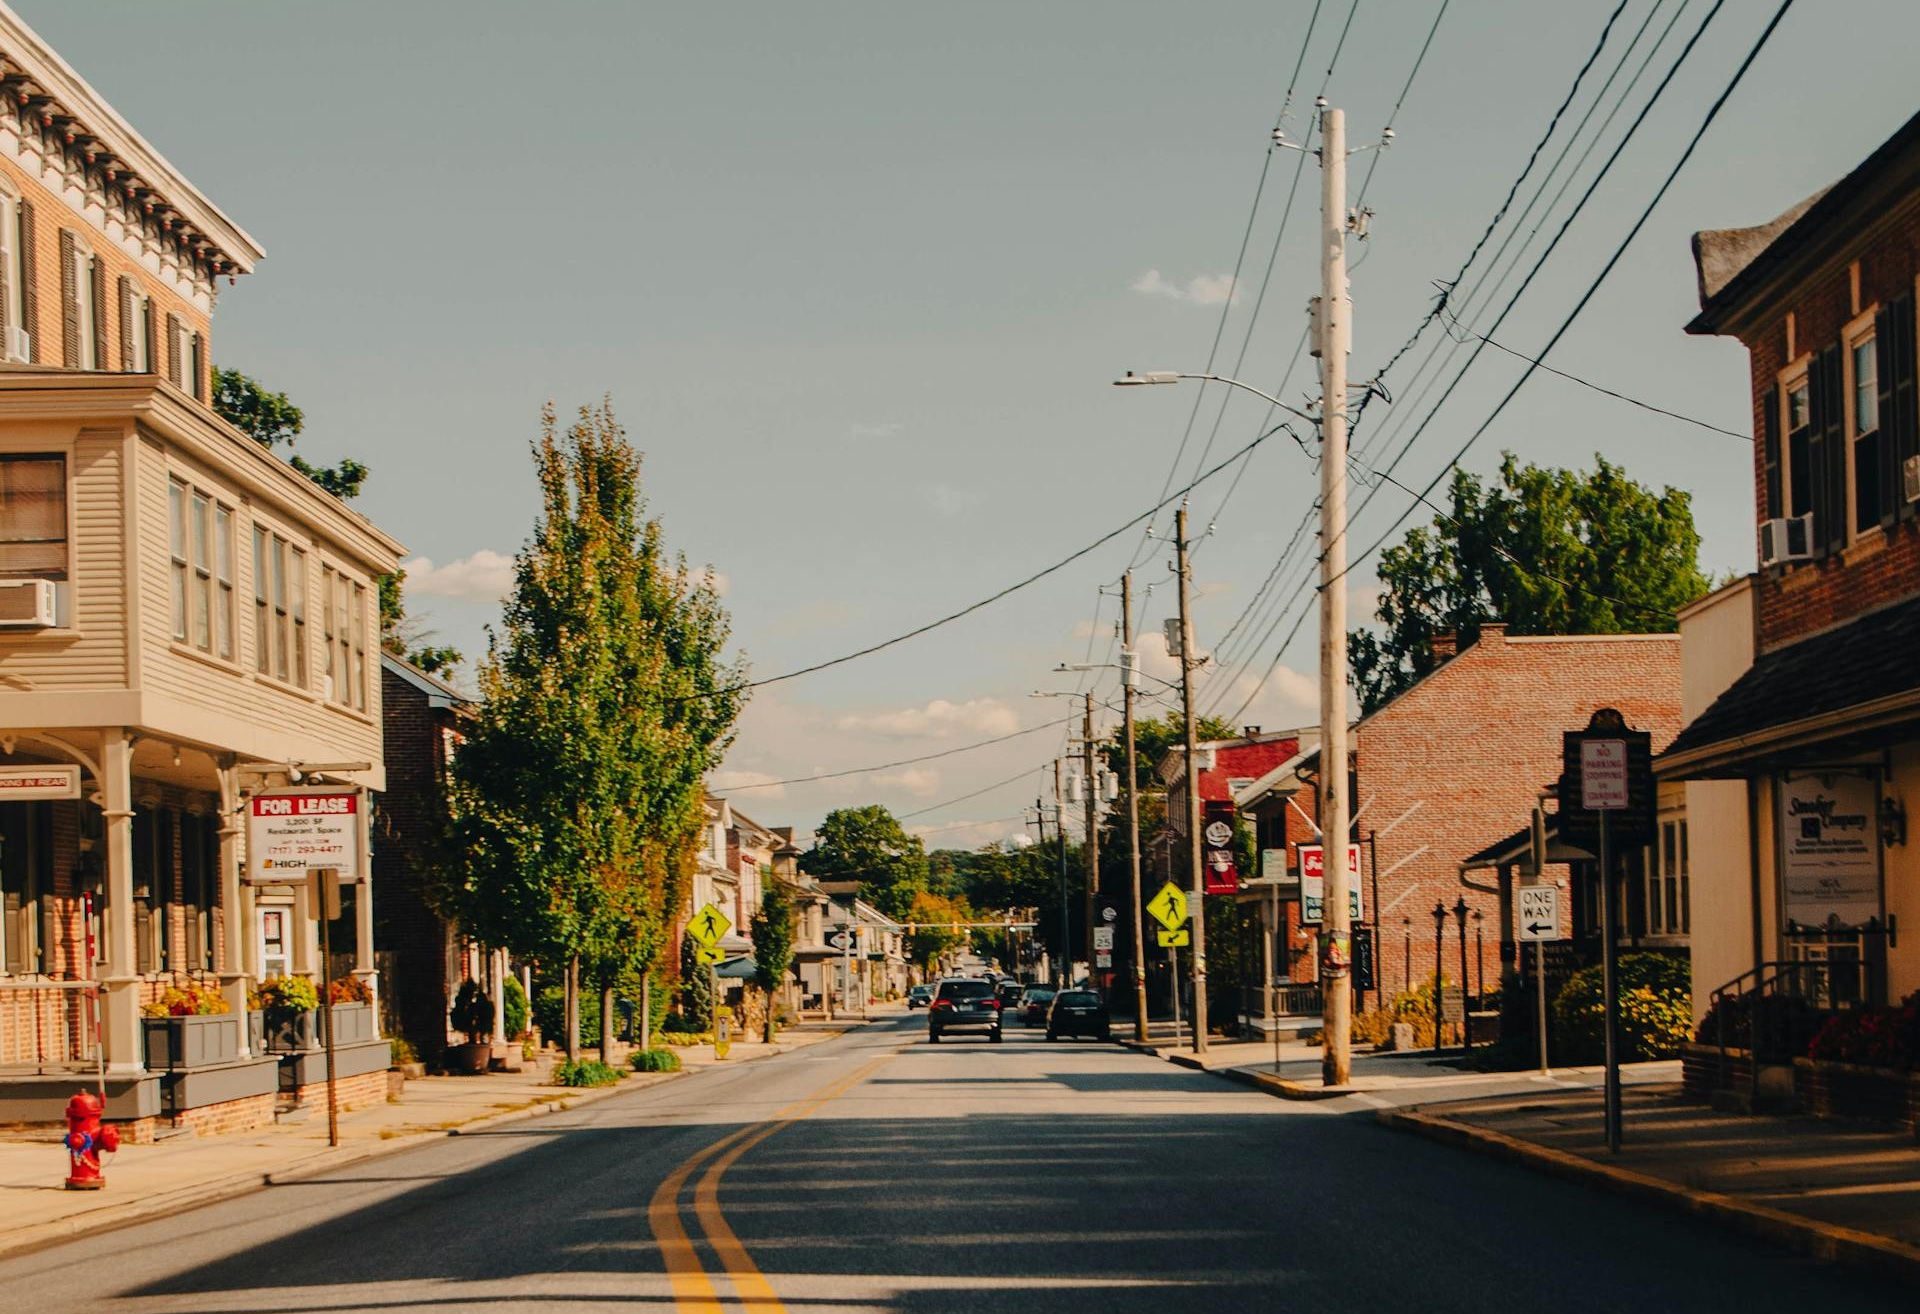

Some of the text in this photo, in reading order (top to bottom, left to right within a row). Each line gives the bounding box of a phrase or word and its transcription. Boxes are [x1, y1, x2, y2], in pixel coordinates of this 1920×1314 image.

[1597, 748, 1610, 757] NO
[26, 779, 38, 787] IN
[39, 777, 67, 786] REAR
[260, 798, 349, 815] FOR LEASE
[297, 846, 344, 854] 293-4477
[274, 860, 307, 868] HIGH
[1523, 892, 1552, 904] ONE
[1523, 907, 1552, 918] WAY
[1097, 938, 1111, 947] 25
